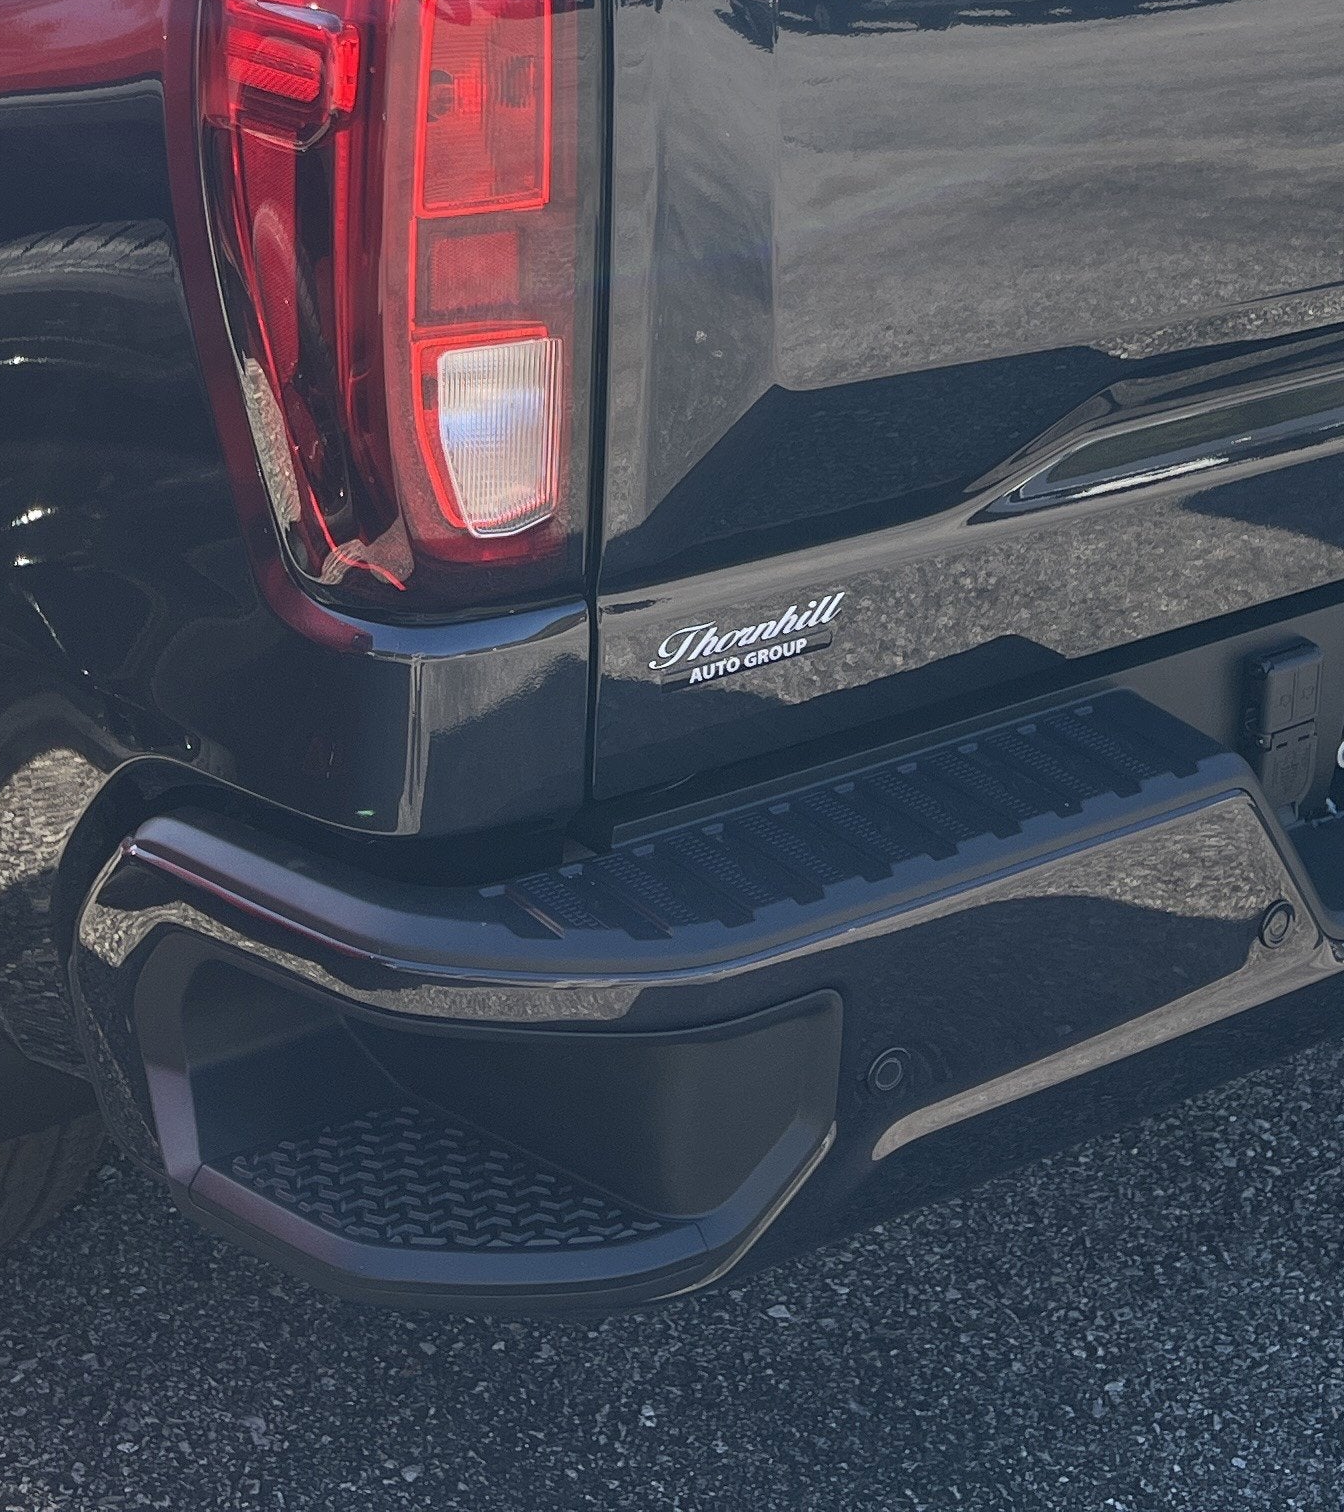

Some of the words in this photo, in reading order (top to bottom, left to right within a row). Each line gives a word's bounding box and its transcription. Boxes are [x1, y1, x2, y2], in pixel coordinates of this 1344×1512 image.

[649, 591, 846, 670] Thornhill
[689, 656, 741, 685] AUTO
[743, 638, 808, 668] GROUP
